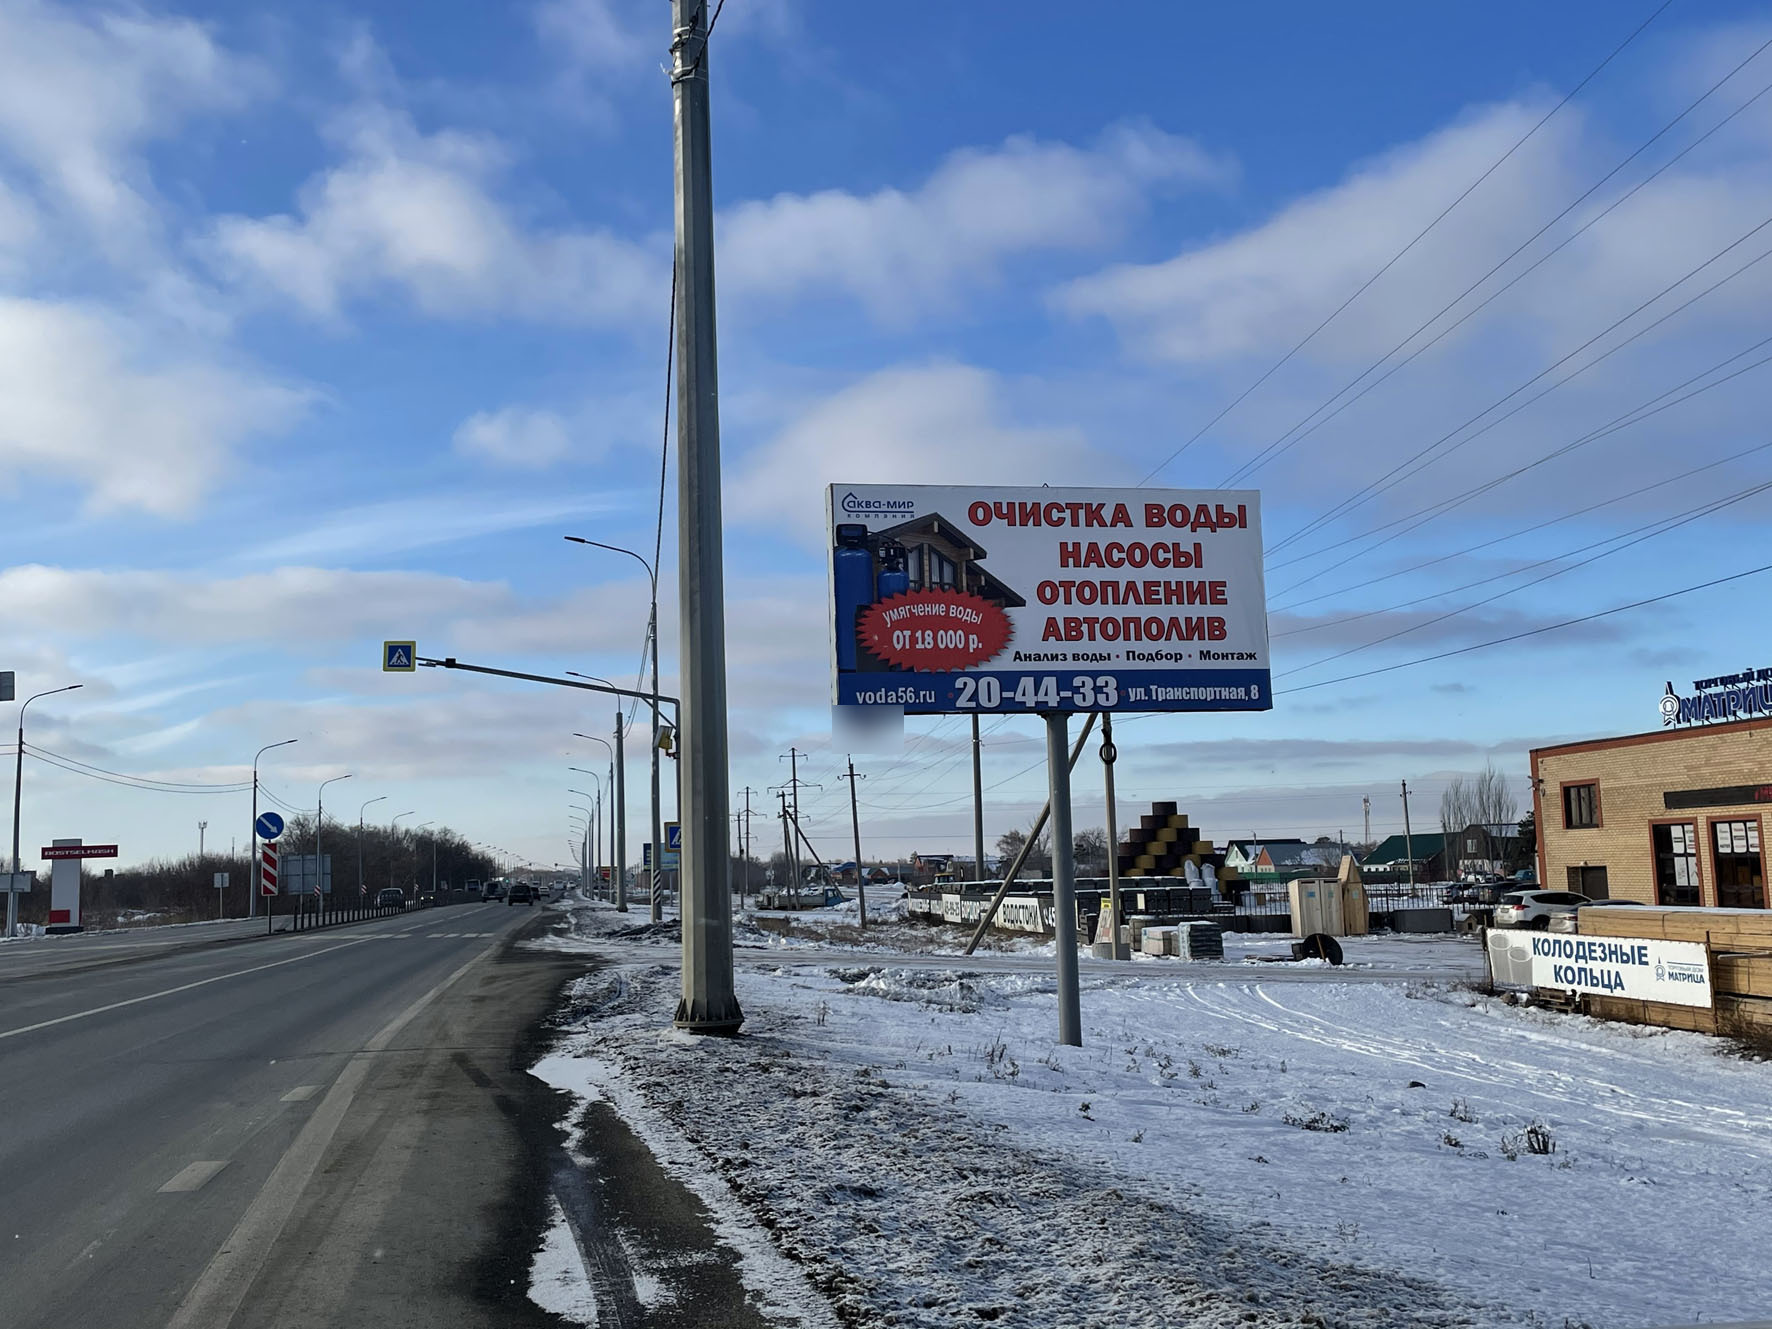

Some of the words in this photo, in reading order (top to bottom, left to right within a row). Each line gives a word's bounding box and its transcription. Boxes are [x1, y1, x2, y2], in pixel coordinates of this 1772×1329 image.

[968, 501, 1133, 528] ОЧИСТКА
[1144, 503, 1248, 533] ВОДЫ
[1059, 541, 1204, 569] НАСОСЫ
[1036, 580, 1228, 606] ОТОПЛЕНИЕ
[882, 603, 946, 628] умягчение
[949, 604, 983, 625] воды
[892, 630, 911, 650] ОТ
[915, 630, 934, 649] 18
[937, 630, 965, 649] 000
[968, 634, 982, 652] р.
[1041, 616, 1228, 642] АВТОПОЛИВ
[1013, 650, 1068, 663] Анализ
[1072, 651, 1111, 664] воды
[1126, 649, 1184, 664] Подбор
[1199, 650, 1258, 662] Монтаж
[856, 687, 935, 704] voda56.ru
[954, 676, 1119, 708] 20-44-33
[1128, 686, 1149, 702] ул.
[1251, 684, 1260, 700] 8
[1532, 937, 1649, 966] КОЛОДЕЗНЫЕ
[1553, 964, 1625, 993] КОЛЬЦА
[1668, 971, 1705, 984] МАТРИЦА
